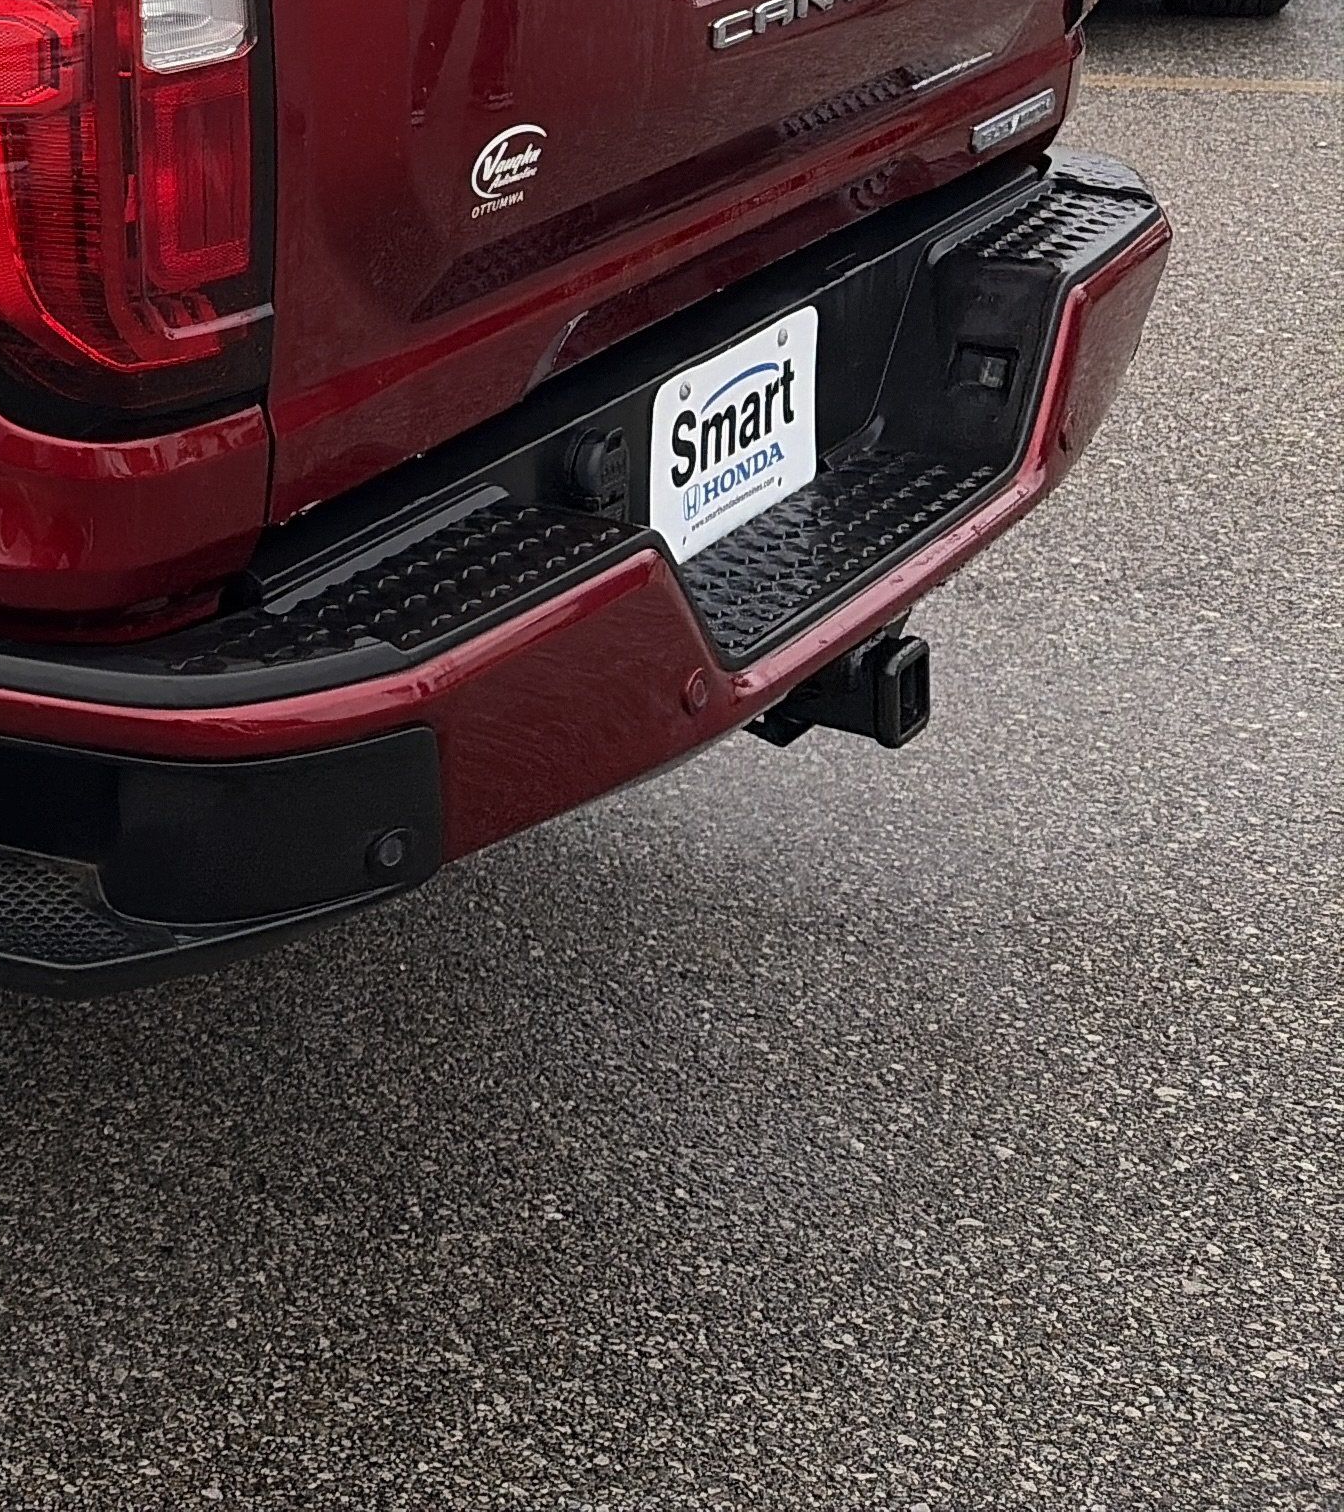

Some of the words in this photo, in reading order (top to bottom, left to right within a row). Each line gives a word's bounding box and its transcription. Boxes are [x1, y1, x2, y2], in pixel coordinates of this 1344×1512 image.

[482, 141, 542, 182] Vaughn
[471, 190, 525, 219] OTTUMWA
[671, 358, 795, 488] Smart
[702, 443, 785, 505] HONDA
